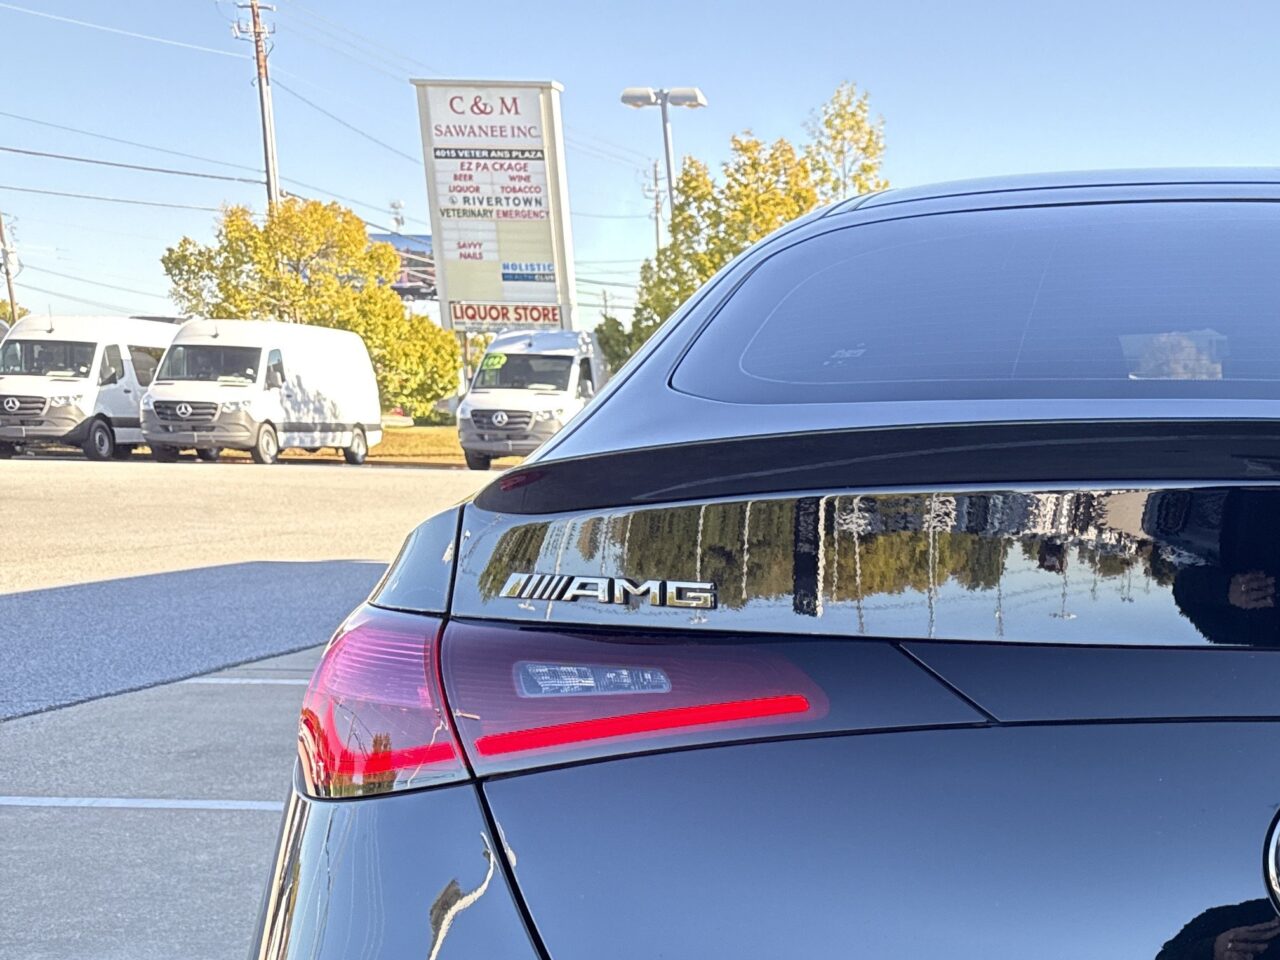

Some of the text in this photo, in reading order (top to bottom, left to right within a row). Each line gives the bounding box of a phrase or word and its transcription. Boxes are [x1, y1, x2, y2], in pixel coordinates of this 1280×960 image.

[449, 95, 521, 115] C & M
[434, 124, 509, 138] SAWANEE
[435, 149, 457, 158] 4015
[512, 150, 543, 159] PLAZA
[459, 161, 473, 171] EZ
[449, 185, 480, 193] LIQUOR
[500, 185, 542, 194] TOBACCO
[462, 196, 543, 207] RIVERTOWN
[440, 208, 550, 219] VETERINARY EMERGENCY
[459, 252, 483, 260] NAILS
[502, 262, 555, 272] HOLISTIC
[453, 305, 559, 322] LIQUOR STORE
[562, 575, 718, 609] AMG
